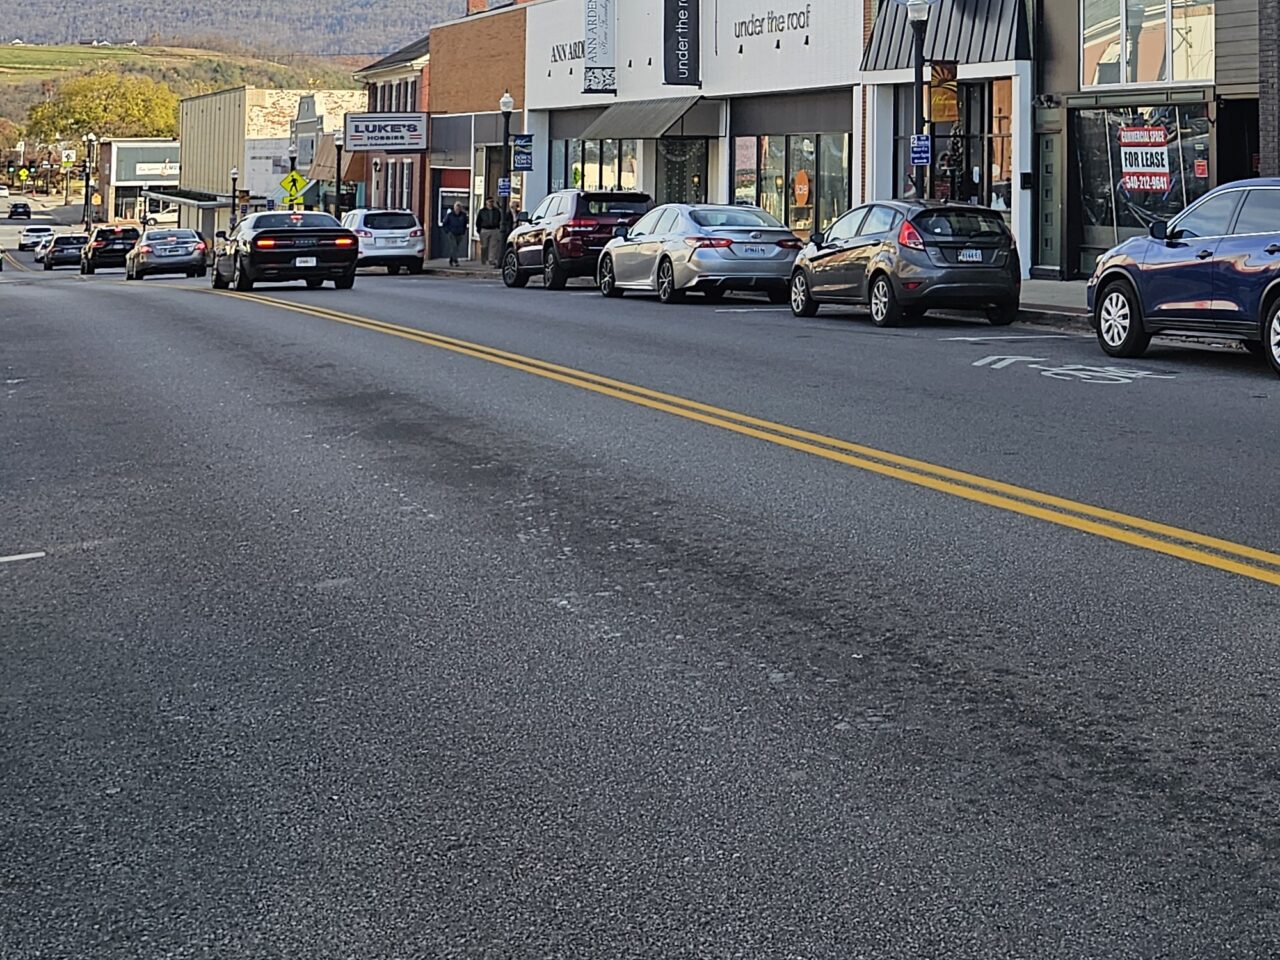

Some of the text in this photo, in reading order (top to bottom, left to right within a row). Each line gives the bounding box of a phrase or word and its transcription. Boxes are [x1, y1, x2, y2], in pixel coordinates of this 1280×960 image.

[675, 9, 689, 33] the
[734, 3, 811, 38] under the roof
[550, 43, 568, 63] ANN
[587, 38, 597, 63] ANN
[675, 37, 689, 78] under
[354, 123, 418, 133] LUKE'S
[1121, 130, 1165, 142] COMMERCIAL SPACE
[1124, 151, 1165, 168] FOR LEASE
